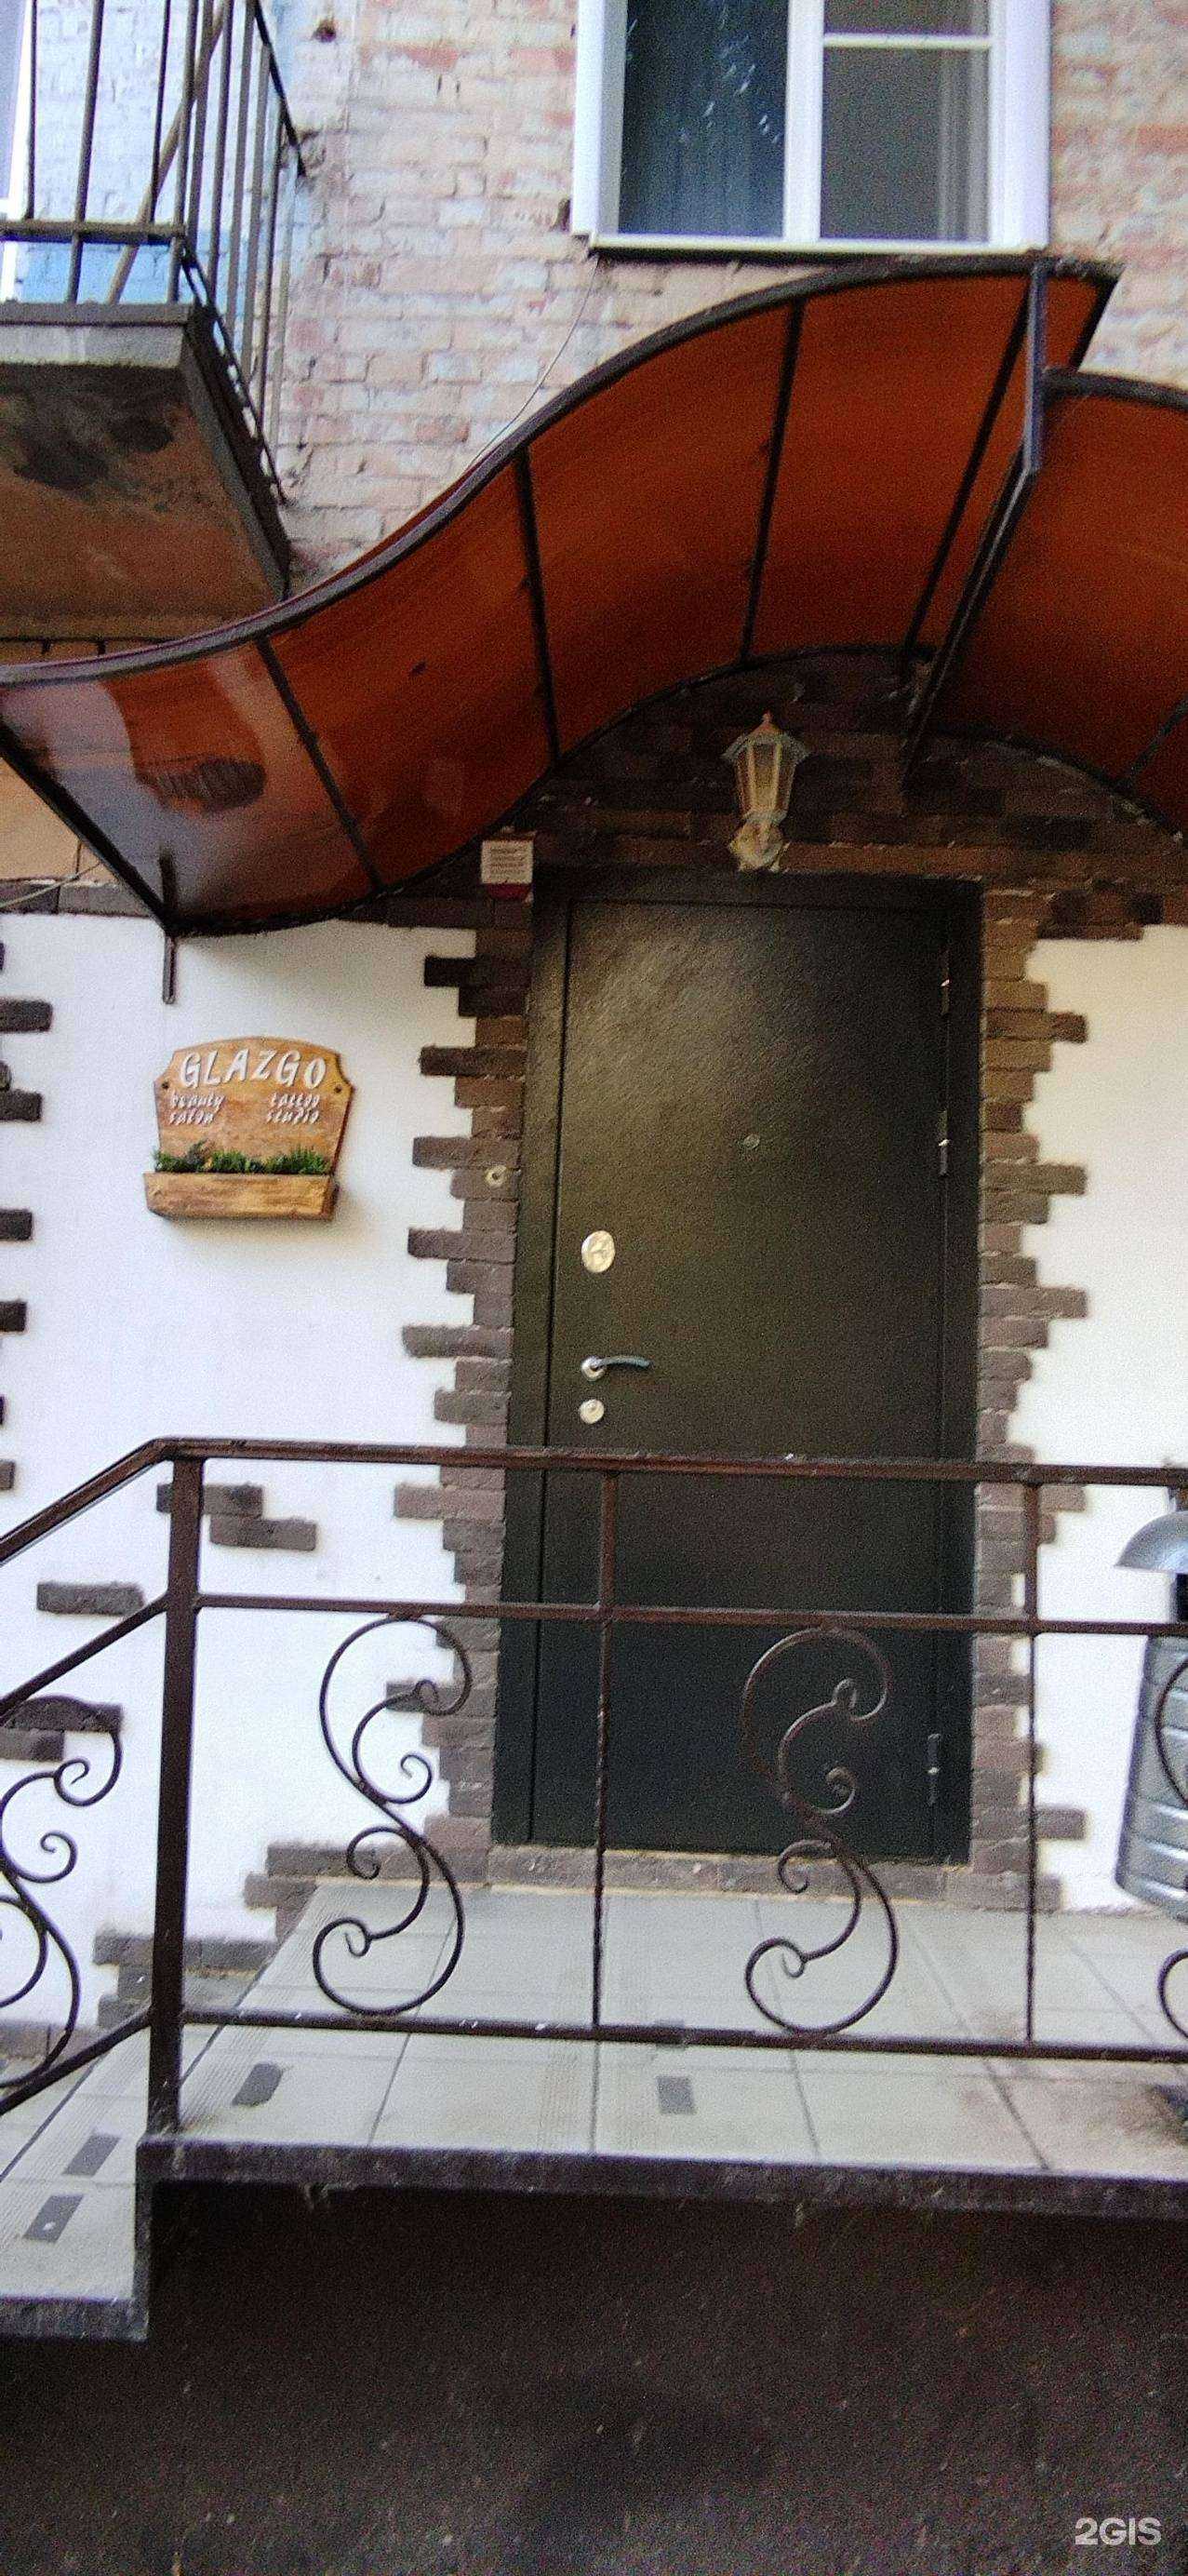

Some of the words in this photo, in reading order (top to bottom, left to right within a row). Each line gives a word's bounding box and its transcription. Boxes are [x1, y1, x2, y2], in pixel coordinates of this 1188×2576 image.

[180, 1049, 327, 1089] GLAZGO
[170, 1090, 225, 1110] beauty
[270, 1093, 321, 1108] tattoo
[169, 1108, 215, 1125] salon
[267, 1107, 319, 1124] studio
